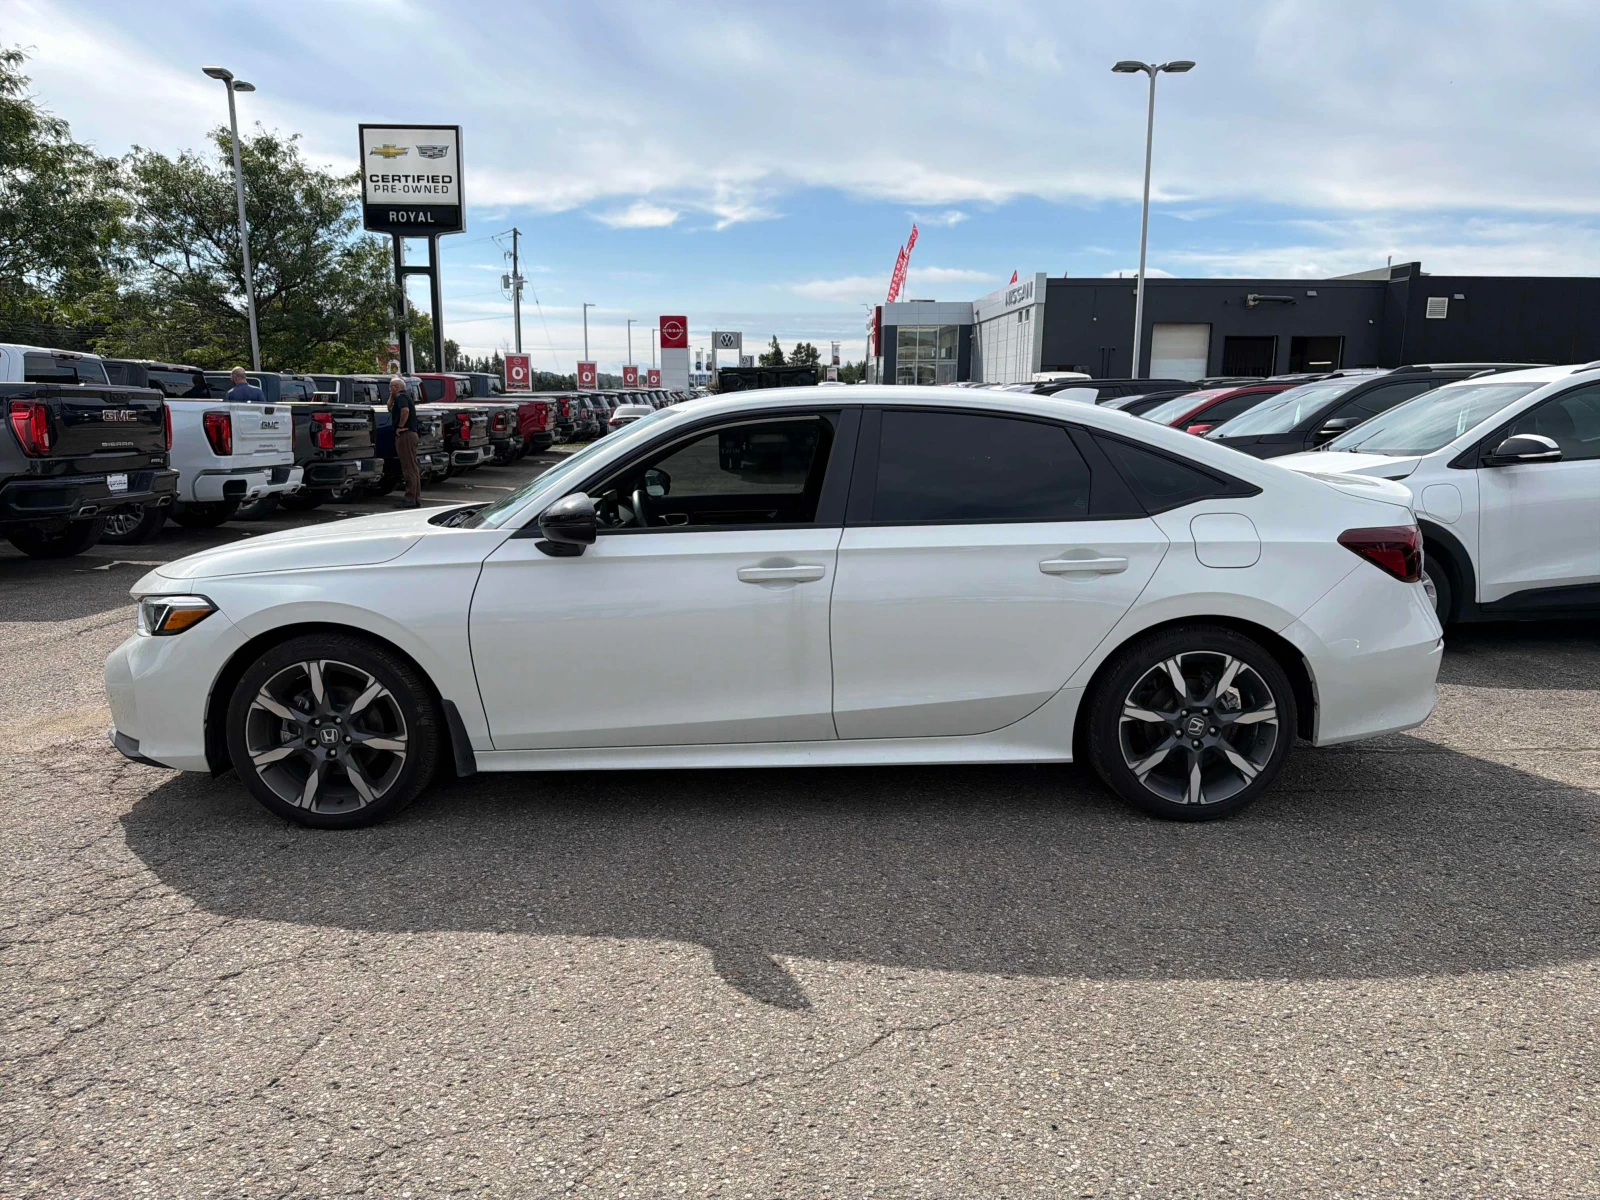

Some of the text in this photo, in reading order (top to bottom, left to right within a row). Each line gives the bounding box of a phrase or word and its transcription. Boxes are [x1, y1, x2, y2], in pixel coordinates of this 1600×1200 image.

[369, 174, 452, 184] CERTIFIED
[374, 185, 449, 194] PRE-OWNED
[389, 211, 435, 223] ROYAL
[1005, 281, 1033, 307] NISSAN
[102, 409, 138, 422] GMC
[260, 421, 279, 430] GMC
